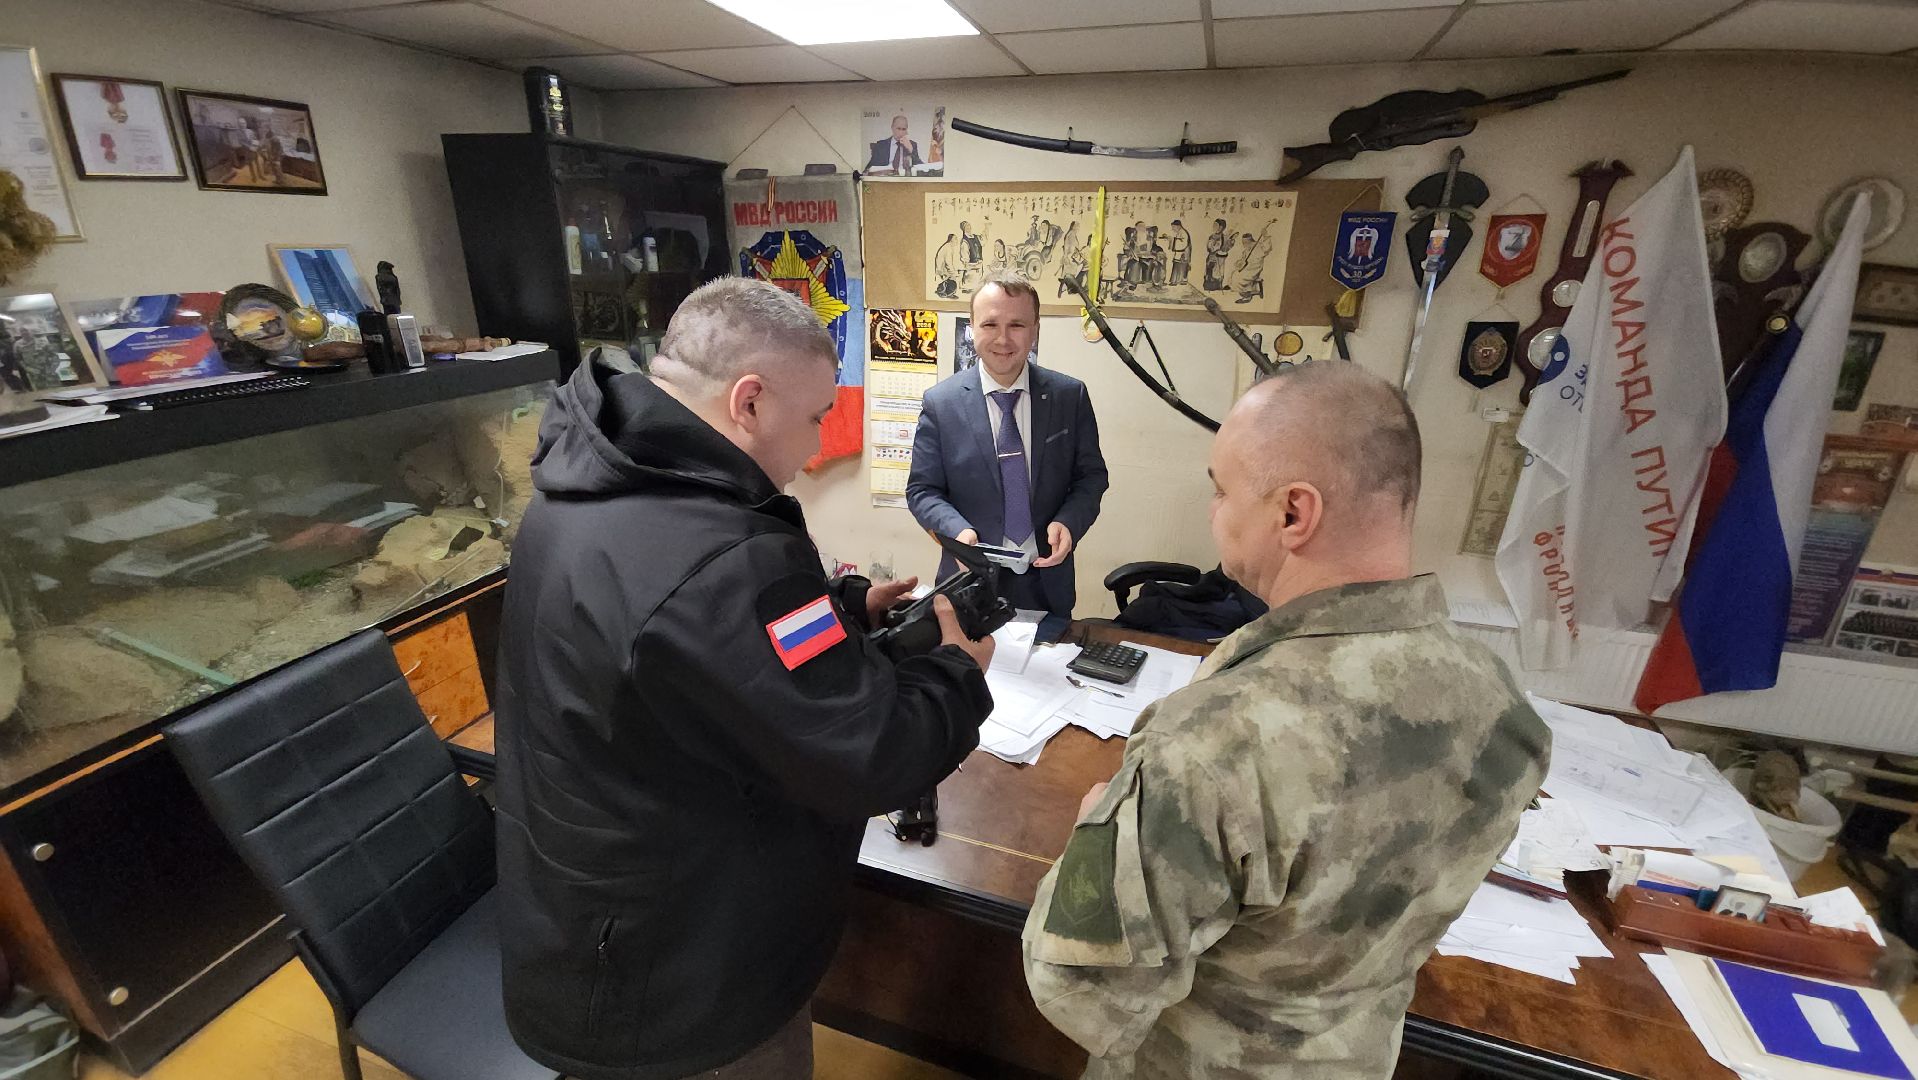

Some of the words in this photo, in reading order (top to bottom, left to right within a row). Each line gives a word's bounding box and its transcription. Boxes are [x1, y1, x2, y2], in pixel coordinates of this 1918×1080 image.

[733, 202, 772, 228] МВД
[774, 199, 839, 224] РОССИИ
[1602, 216, 1657, 435] КОМАНДА
